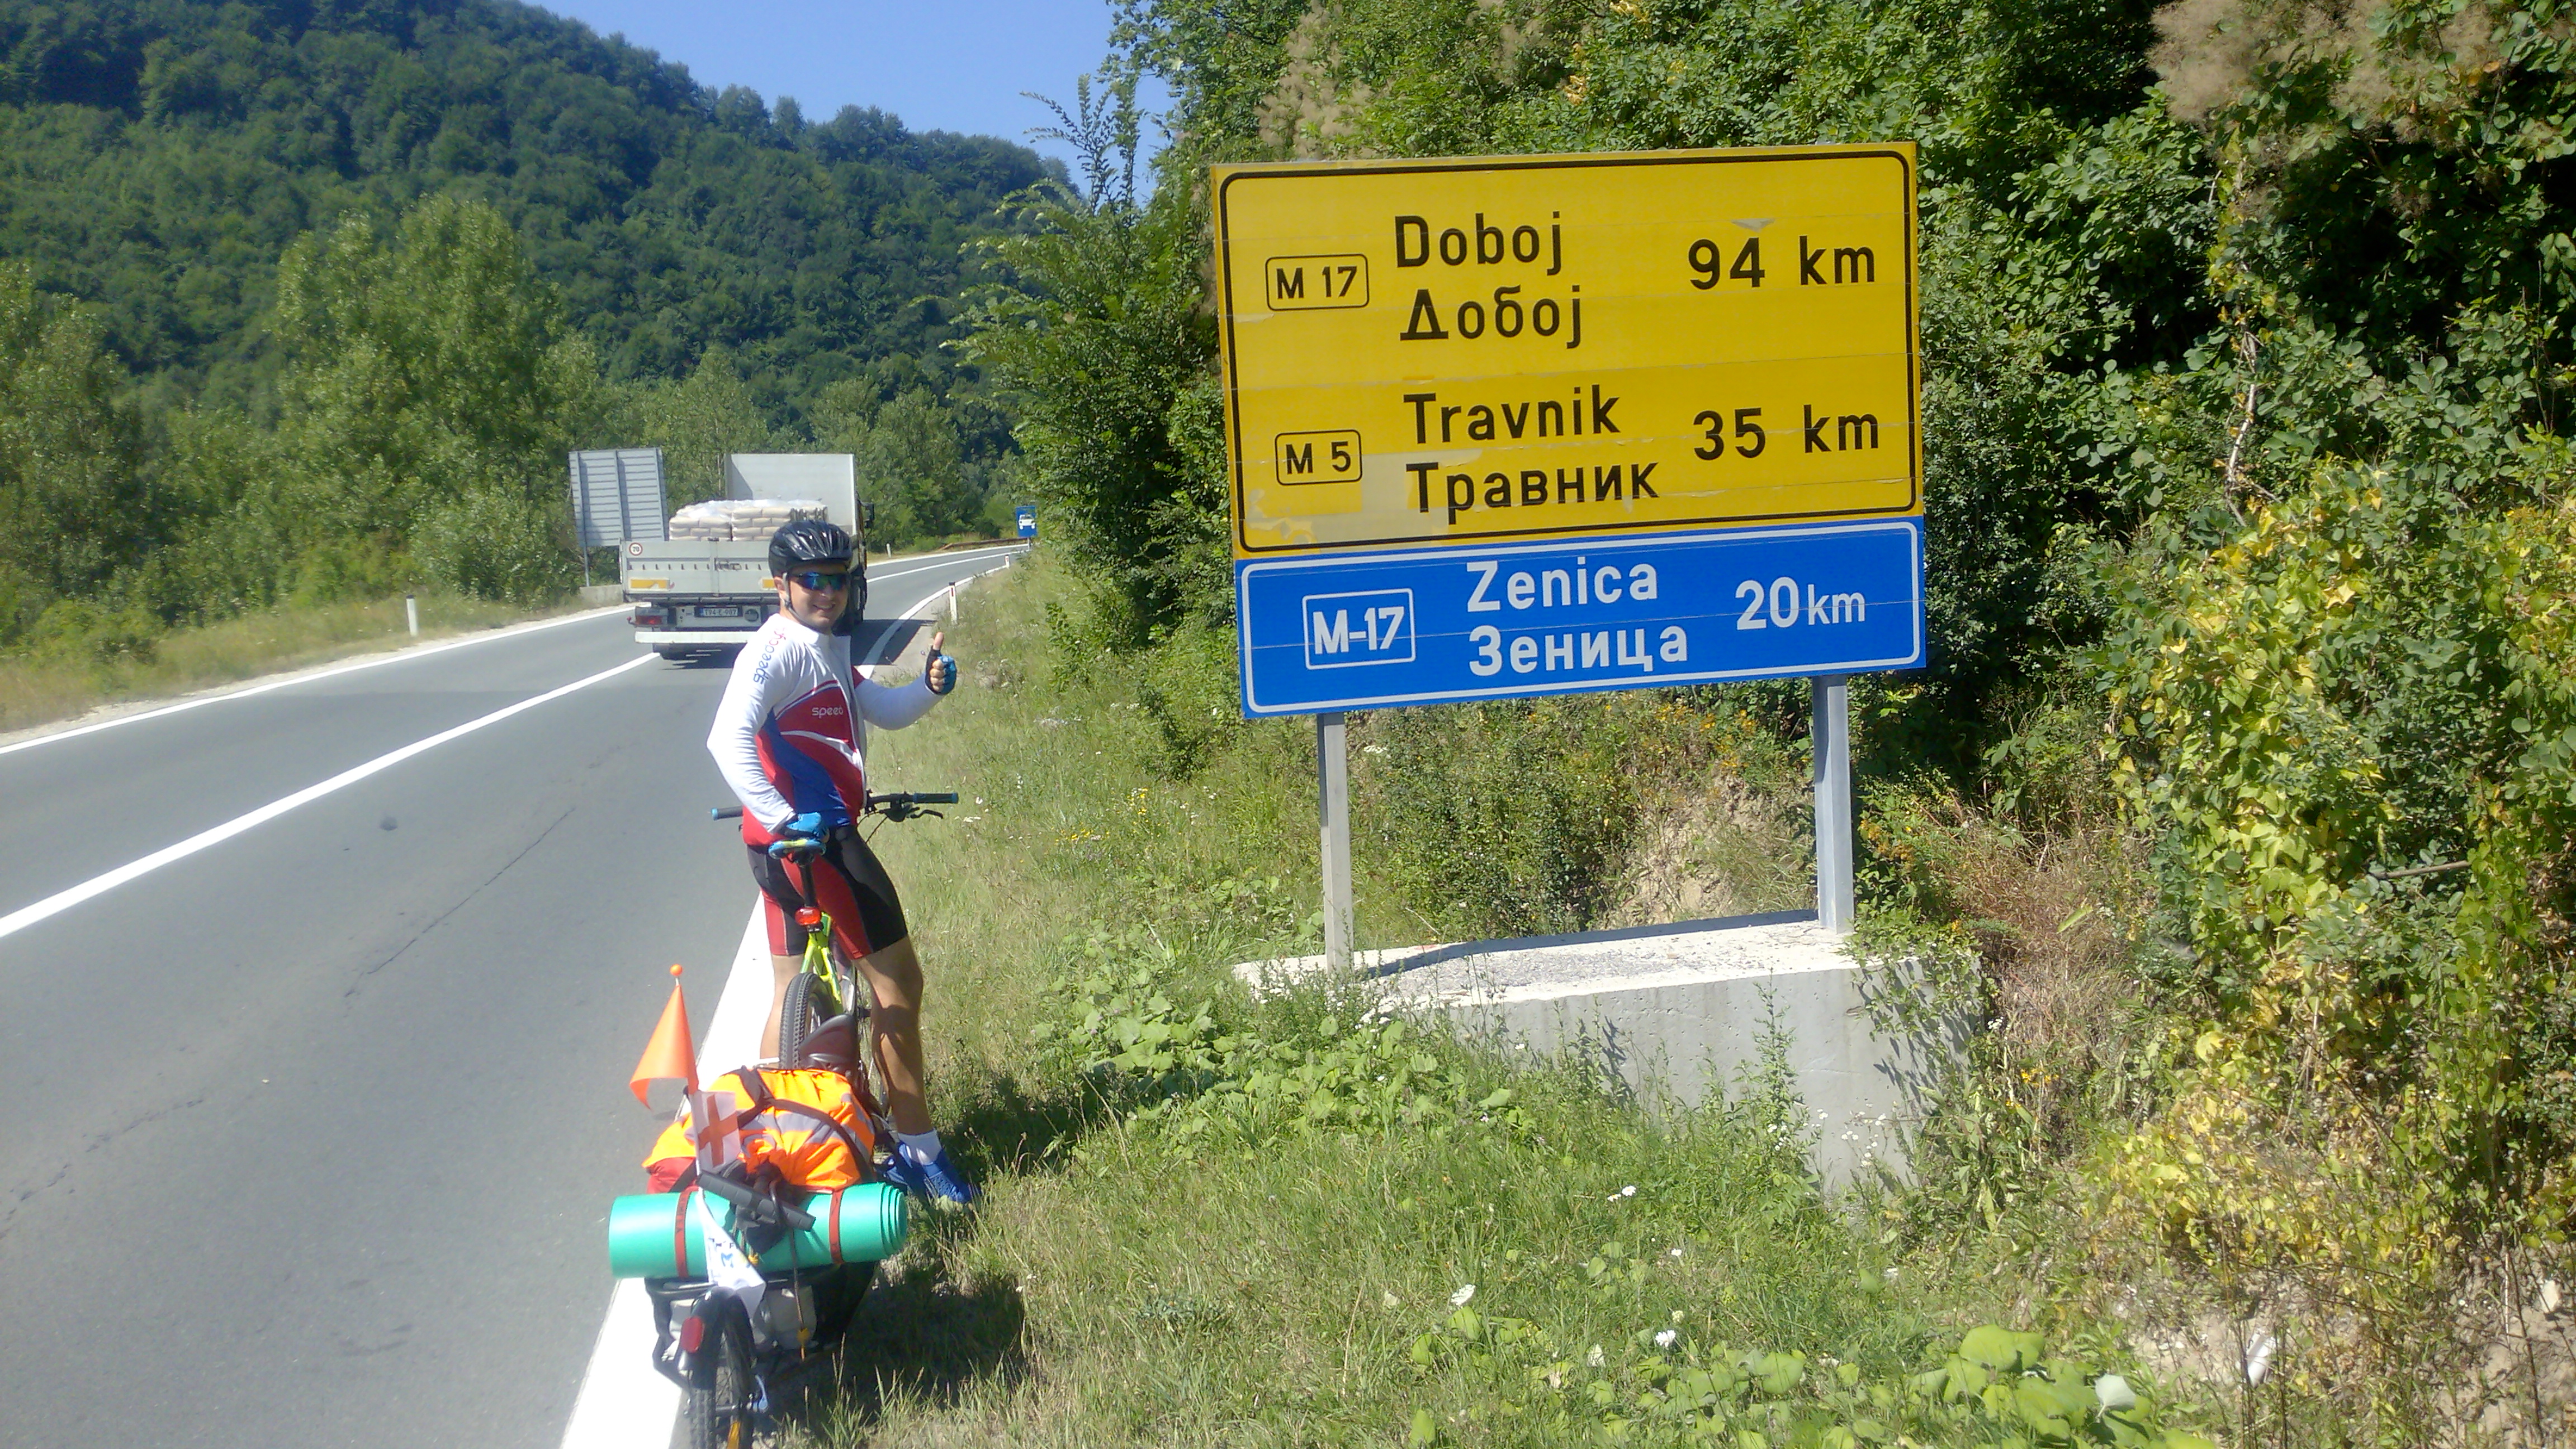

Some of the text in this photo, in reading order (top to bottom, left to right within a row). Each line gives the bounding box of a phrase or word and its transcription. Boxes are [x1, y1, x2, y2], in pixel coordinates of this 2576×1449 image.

[1394, 211, 1562, 276] Doboj
[1688, 235, 1876, 291] 94 km
[1276, 266, 1357, 300] M 17
[1399, 285, 1581, 349] Добој
[1403, 383, 1621, 444] Travnik
[1693, 404, 1879, 461] 35 km
[1285, 441, 1352, 475] M 5
[1405, 461, 1660, 525] Травник
[1466, 556, 1659, 613] Zenica
[1313, 605, 1405, 655] M-17
[1468, 624, 1688, 677] Зеница
